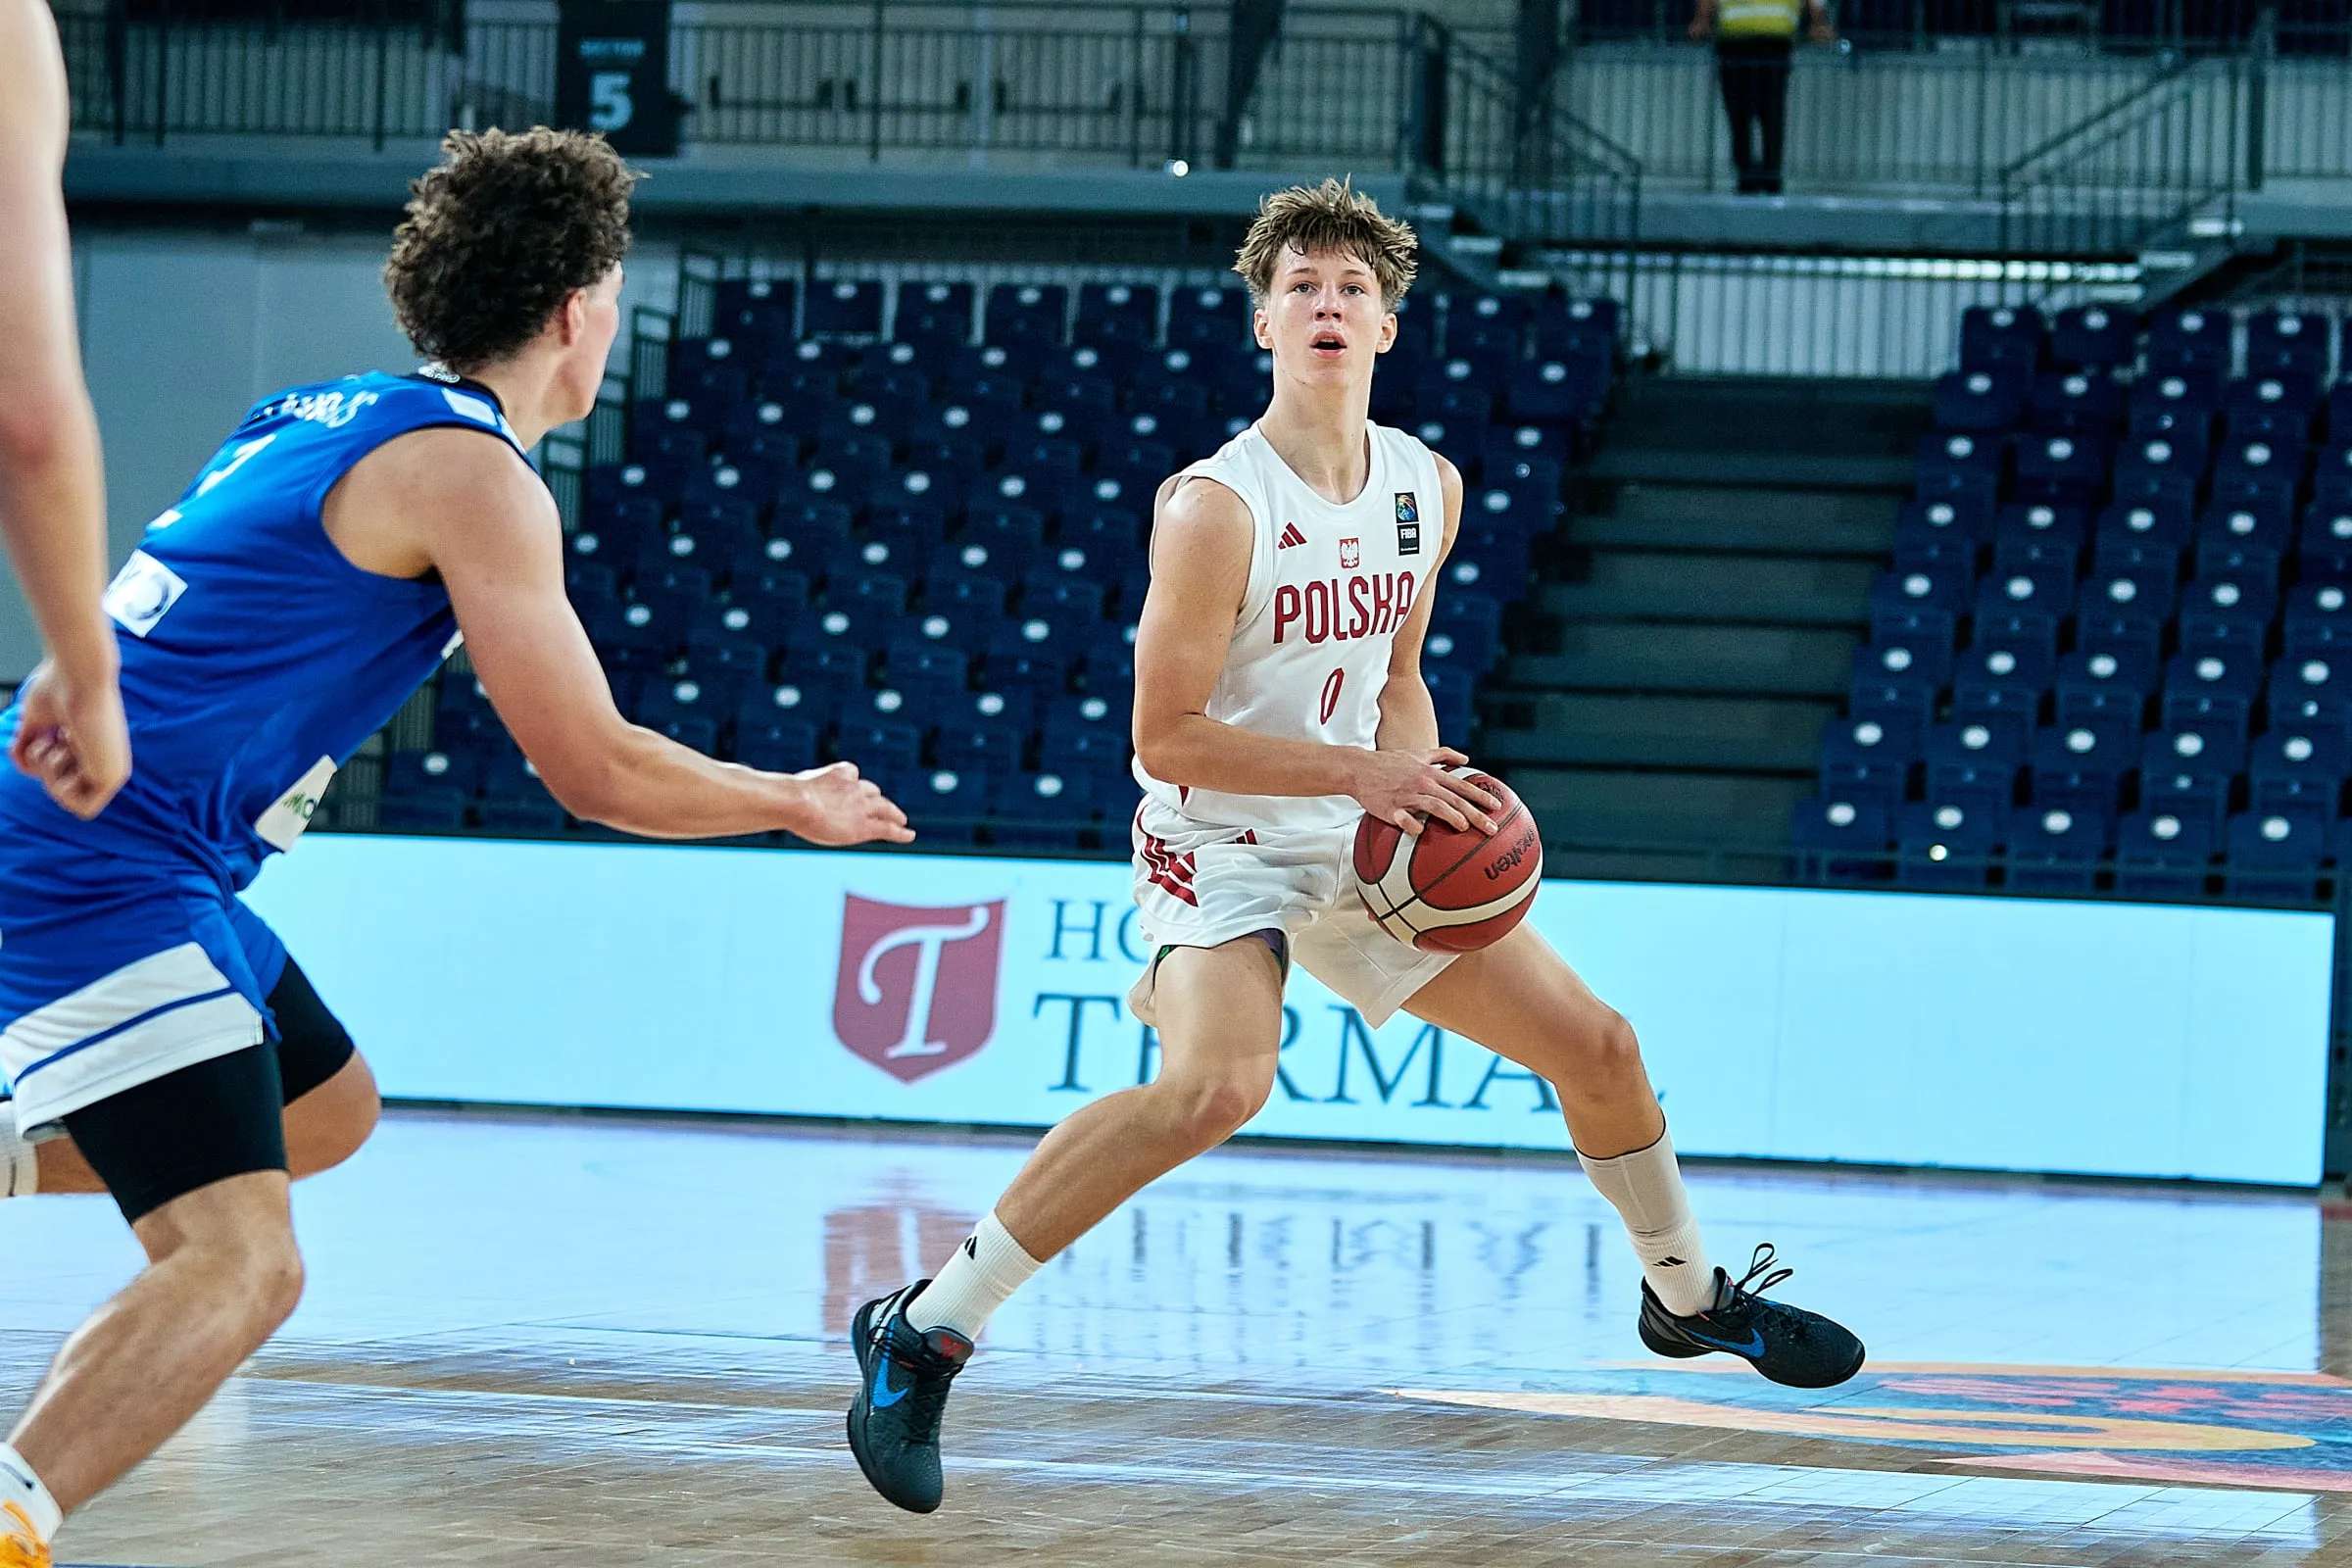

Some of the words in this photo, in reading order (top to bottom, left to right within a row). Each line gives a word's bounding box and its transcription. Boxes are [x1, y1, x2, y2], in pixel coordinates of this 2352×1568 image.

[590, 72, 632, 131] 5
[1399, 527, 1418, 540] FIBA
[1273, 570, 1415, 645] POLSKA
[1320, 667, 1345, 725] 0
